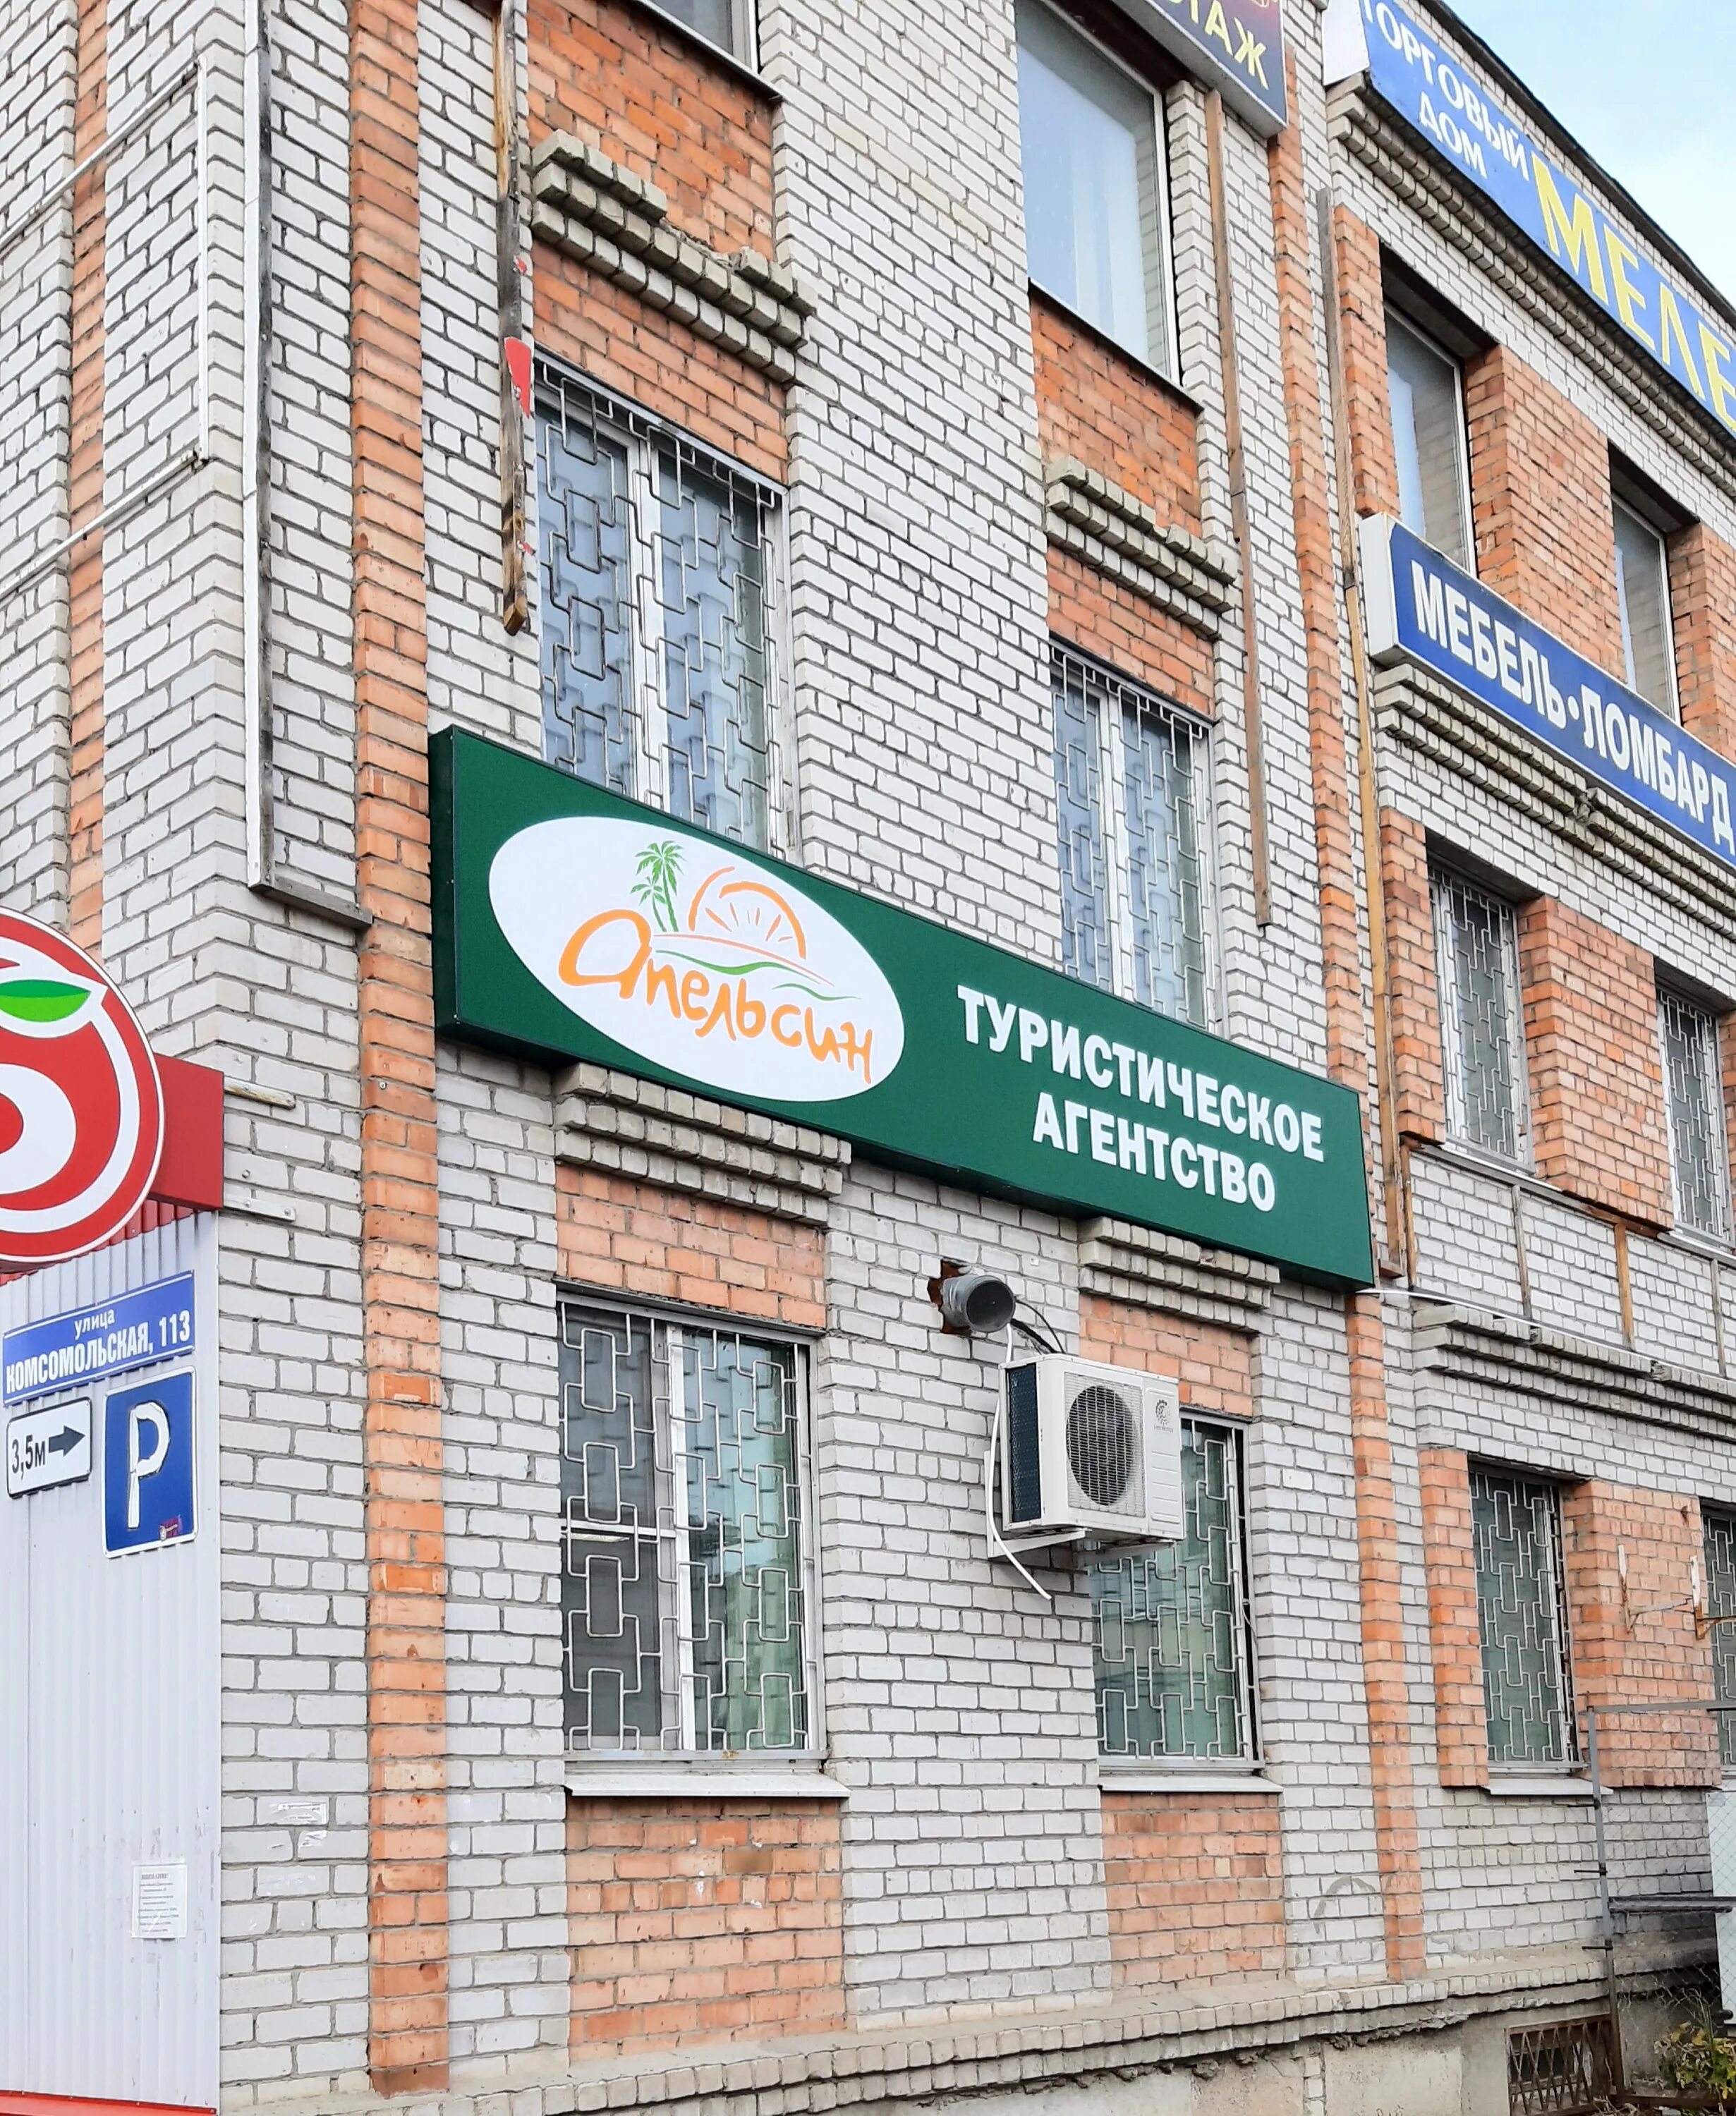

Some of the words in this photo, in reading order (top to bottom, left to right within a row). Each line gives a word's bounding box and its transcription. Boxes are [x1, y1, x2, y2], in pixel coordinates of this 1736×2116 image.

[1164, 0, 1269, 90] АЖ
[1419, 92, 1488, 179] ДОМ
[1411, 561, 1567, 729] МЕБЕЛЬ
[1581, 684, 1735, 856] ЛОМБАРД
[559, 909, 873, 1084] Апельсин
[957, 985, 1324, 1162] ТУРИСТИЧЕСКОЕ
[1032, 1092, 1275, 1212] АГЕНТСТВО
[6, 1322, 153, 1394] КОМСОМОЛЬСКАЯ,
[159, 1310, 190, 1347] 113
[74, 1309, 115, 1340] улица
[128, 1401, 170, 1529] P
